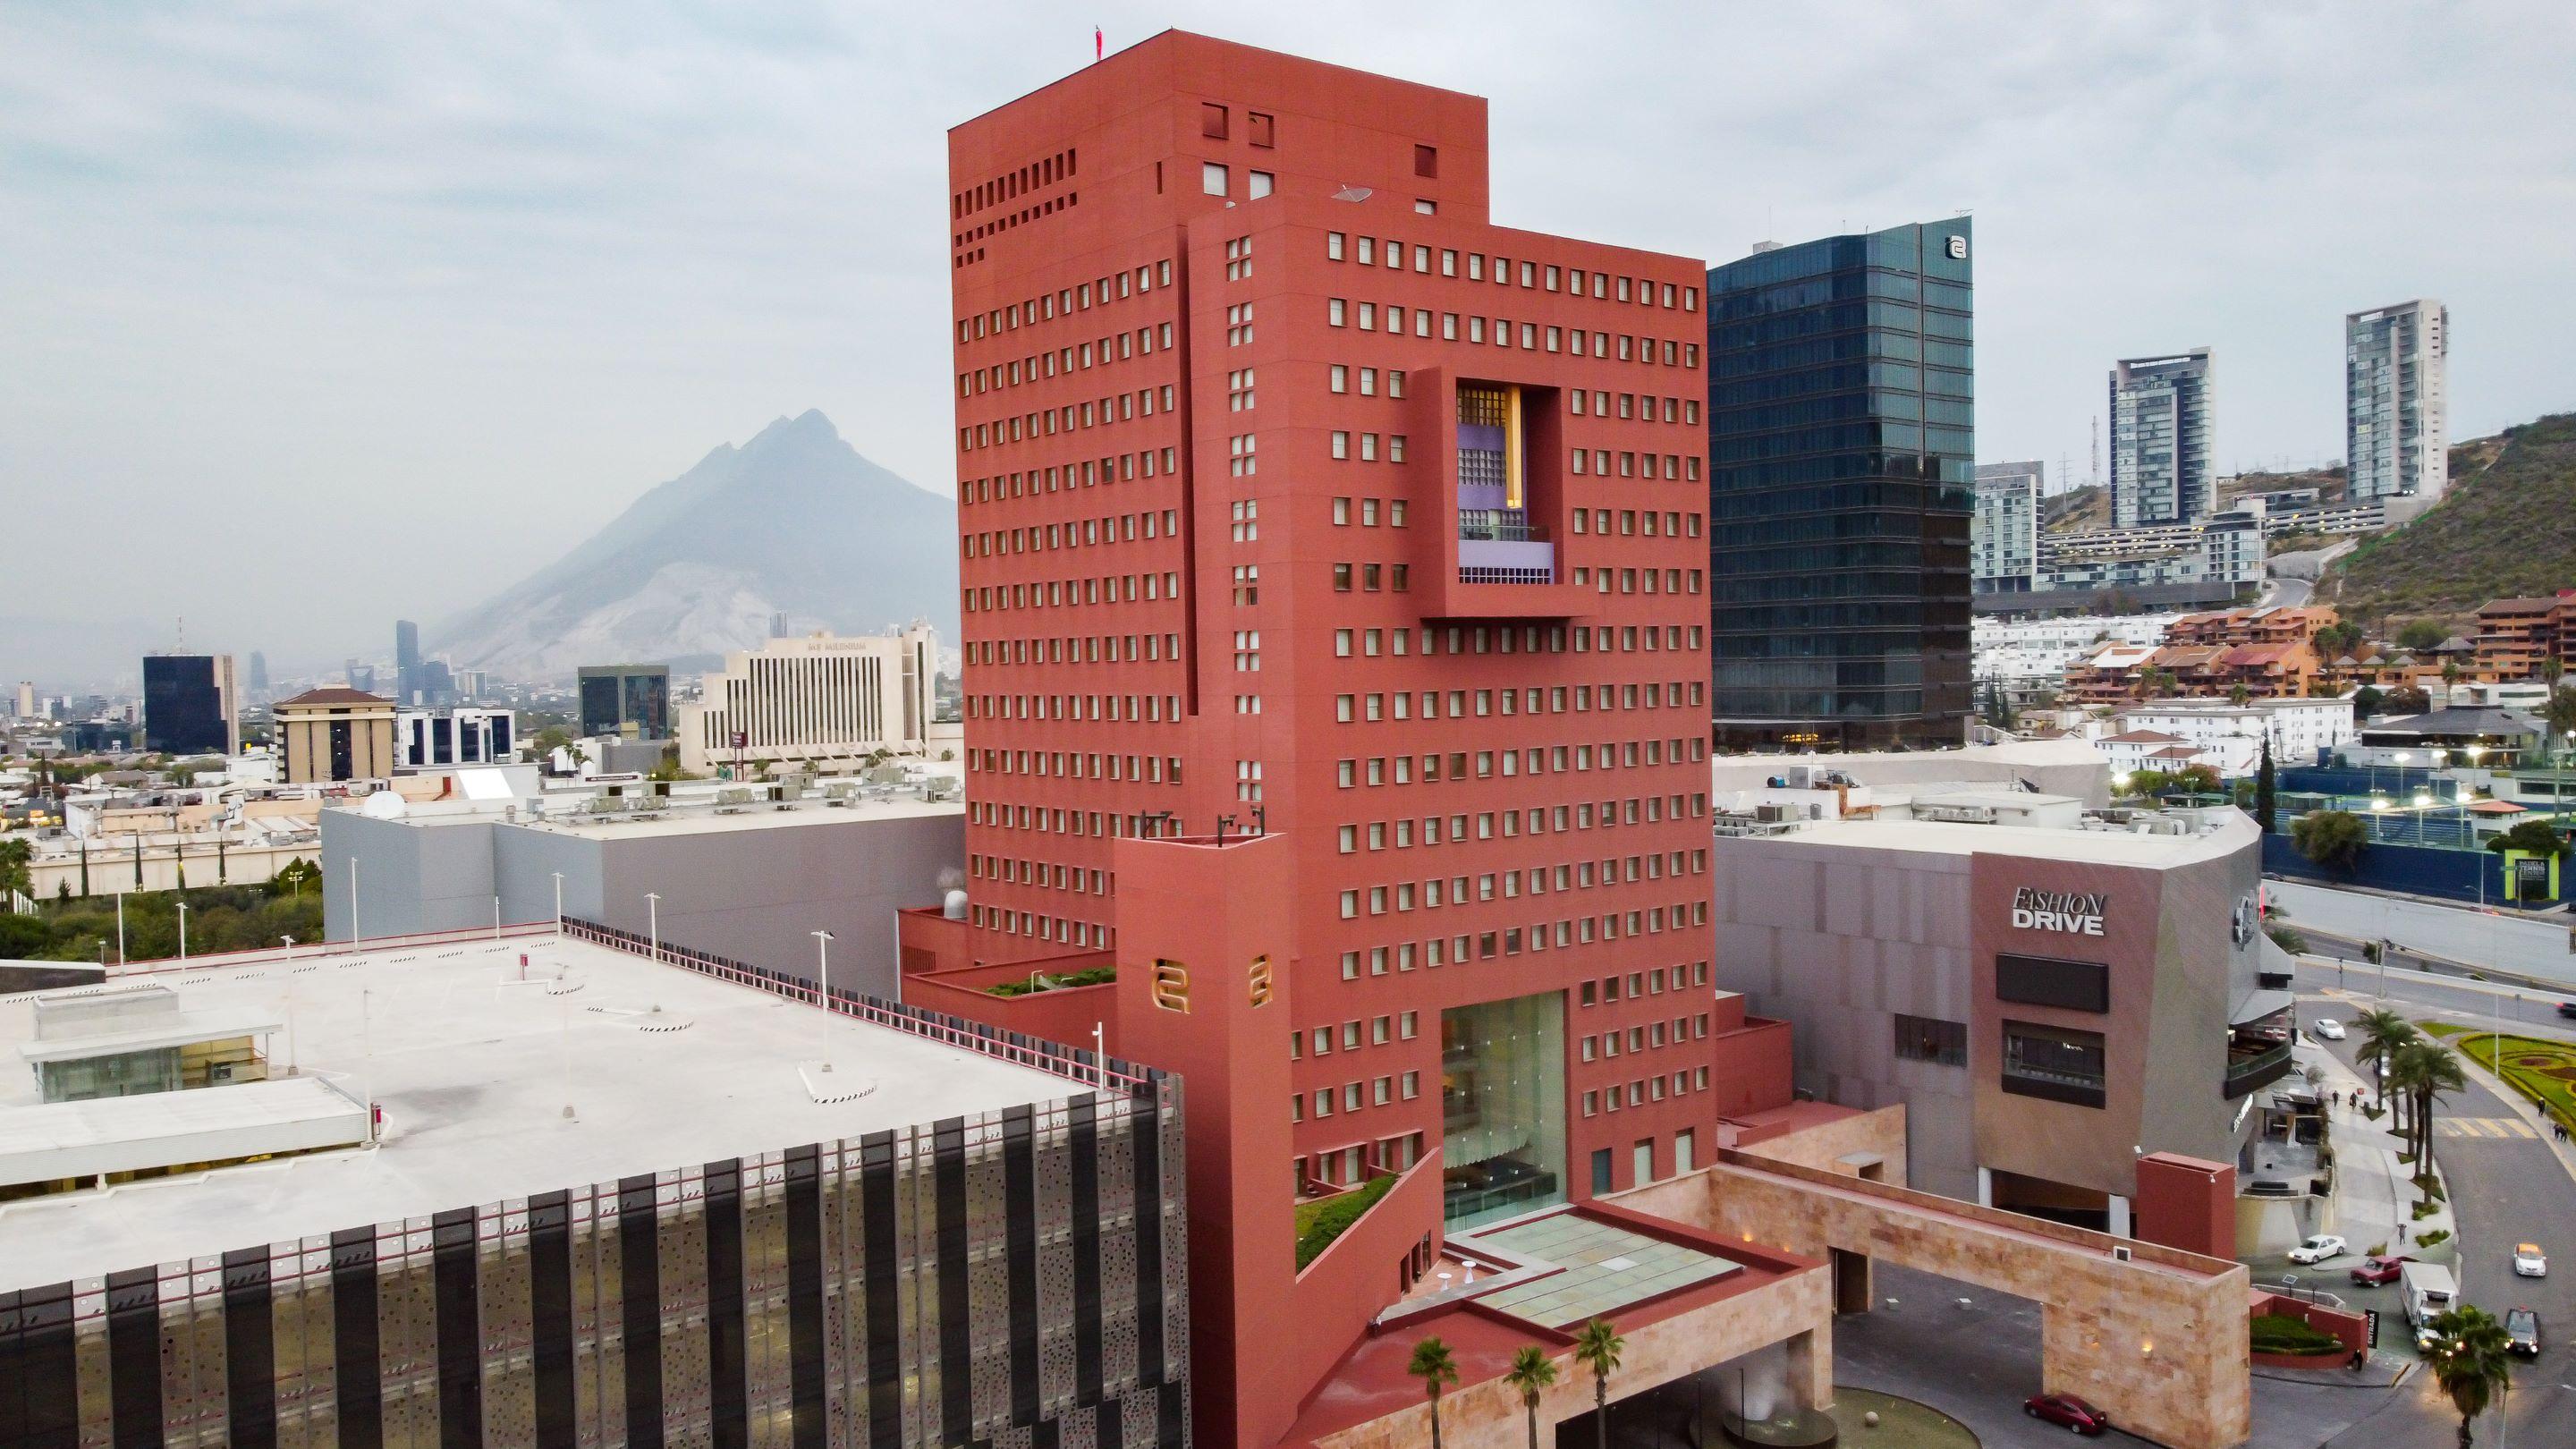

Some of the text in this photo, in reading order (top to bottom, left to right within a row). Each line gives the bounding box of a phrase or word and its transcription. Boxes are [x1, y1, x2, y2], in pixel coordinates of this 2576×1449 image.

[2012, 886, 2105, 916] FASHION
[2012, 909, 2105, 936] DRIVE
[2368, 1313, 2376, 1345] ENTRADA
